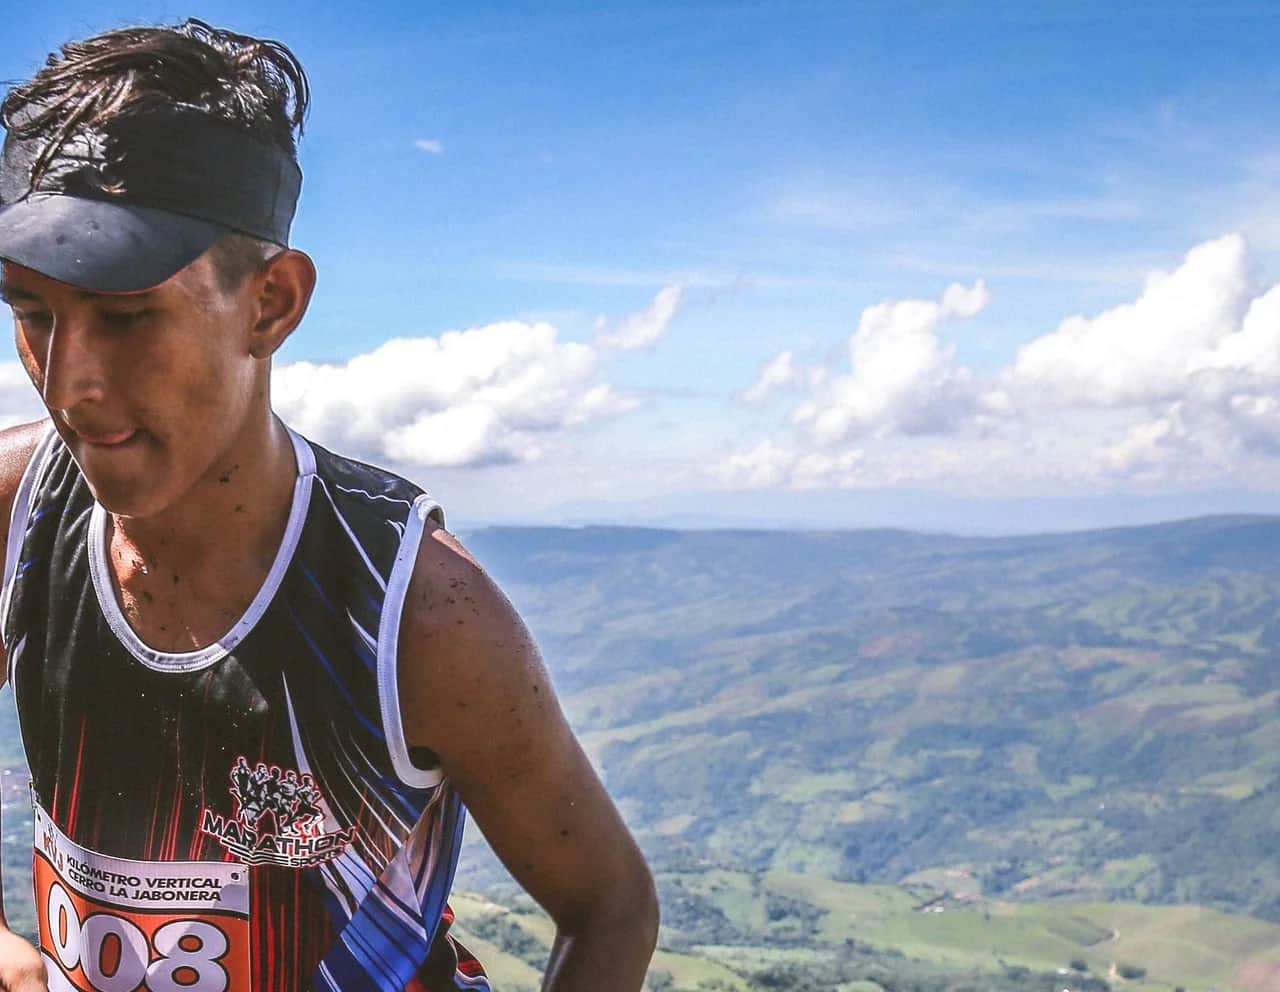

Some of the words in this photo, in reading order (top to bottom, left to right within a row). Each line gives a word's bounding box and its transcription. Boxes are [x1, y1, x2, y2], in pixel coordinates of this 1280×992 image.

[204, 809, 357, 856] MARATHON
[67, 857, 141, 887] KILÓMETRO
[146, 877, 222, 889] VERTICAL
[68, 869, 105, 893] CERRO
[109, 889, 128, 899] LA
[131, 891, 222, 902] JABONERA
